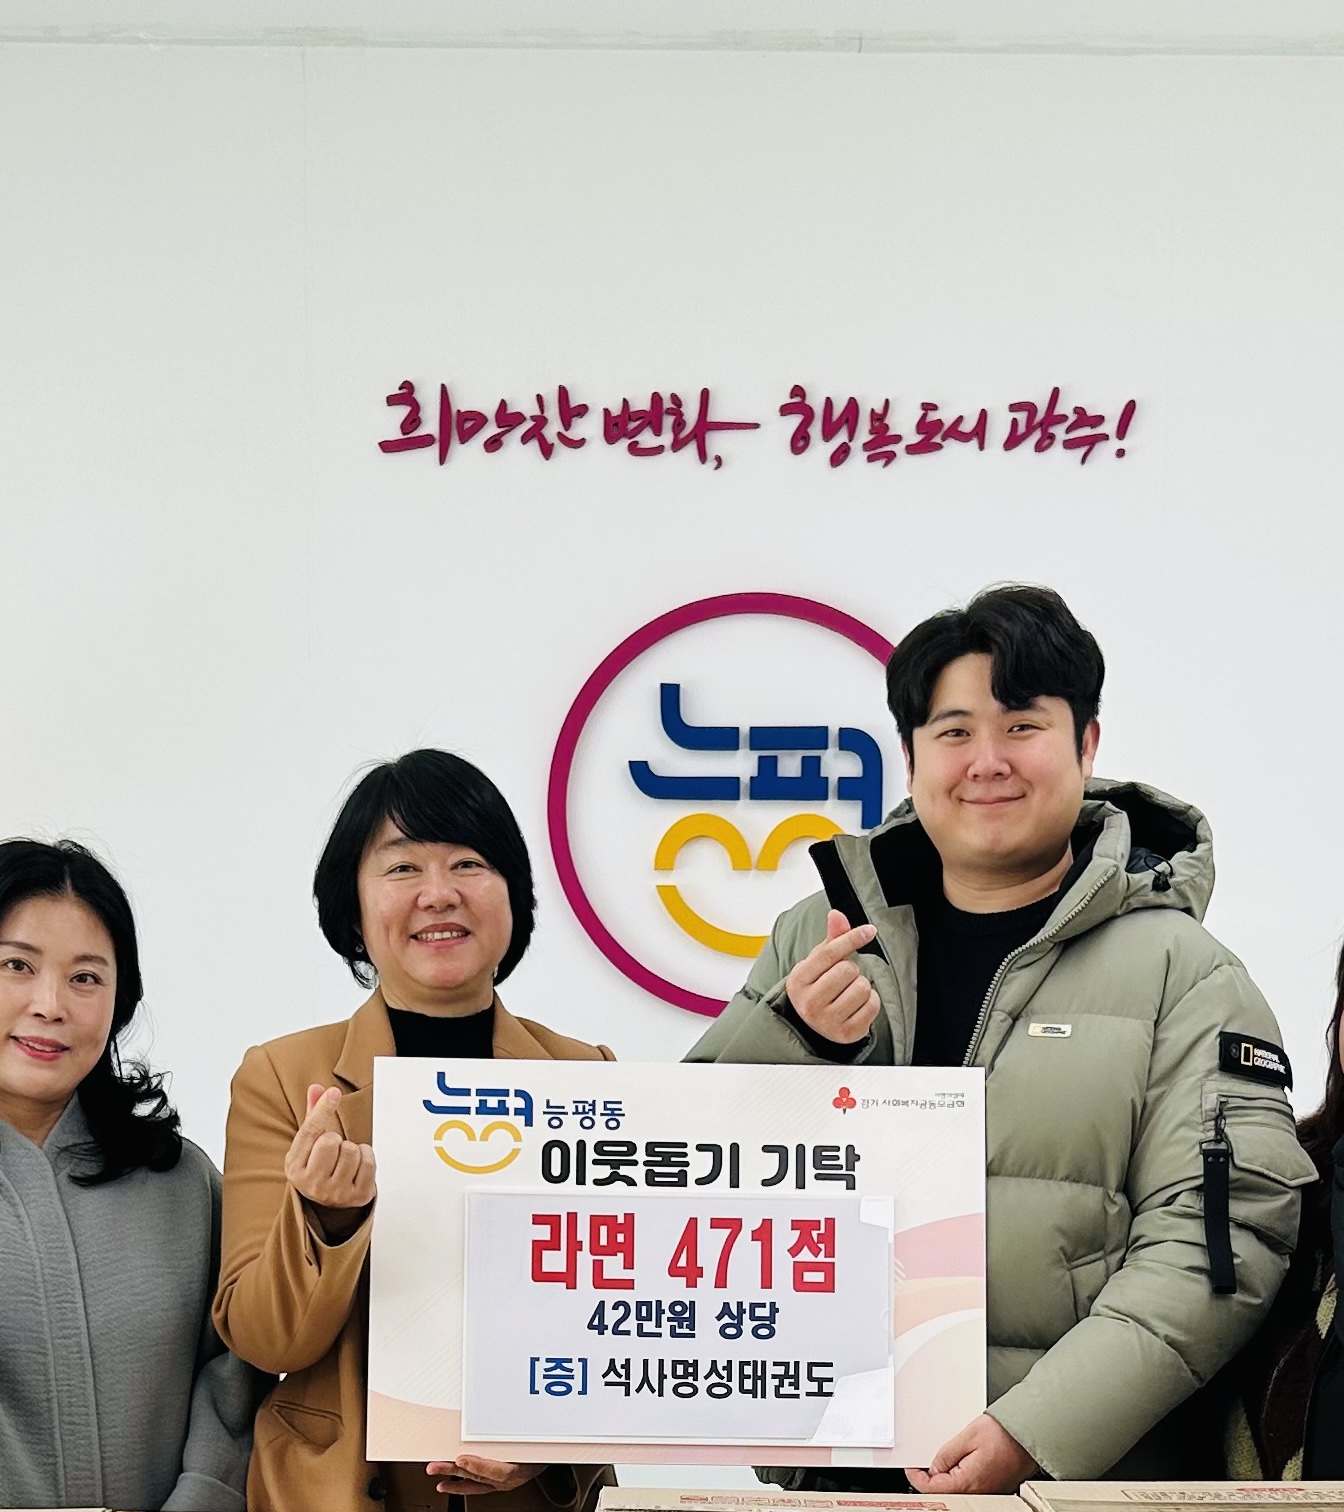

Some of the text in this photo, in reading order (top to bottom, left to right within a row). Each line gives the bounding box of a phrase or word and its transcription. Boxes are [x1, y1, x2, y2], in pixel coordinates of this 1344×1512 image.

[379, 381, 588, 464] 희망찬
[1004, 388, 1135, 462] 광주!
[543, 1099, 625, 1130] 능평동
[542, 1139, 861, 1191] 이웃돕기 기탁
[531, 1211, 836, 1293] 라면 471점
[587, 1300, 779, 1340] 42만원 상당
[530, 1357, 835, 1400] [증] 석사명성태권도
